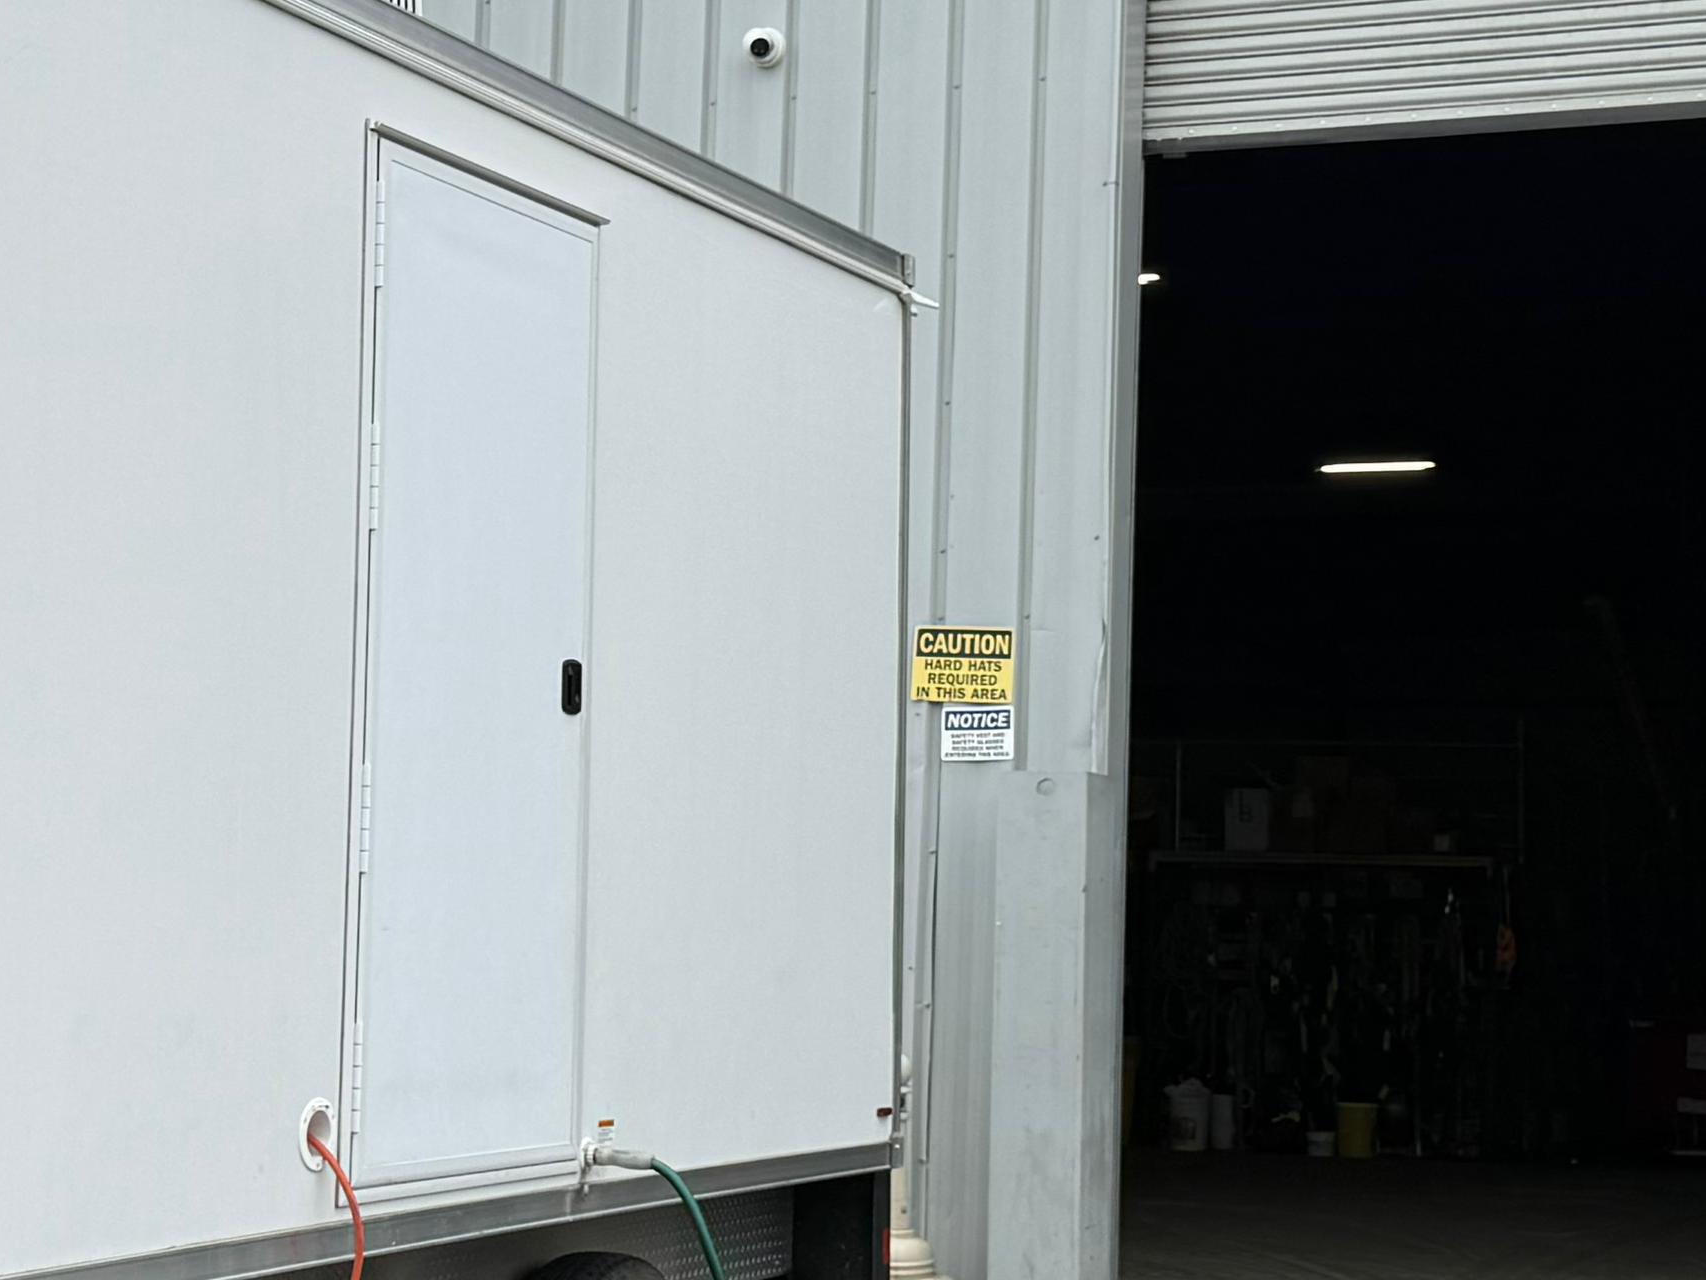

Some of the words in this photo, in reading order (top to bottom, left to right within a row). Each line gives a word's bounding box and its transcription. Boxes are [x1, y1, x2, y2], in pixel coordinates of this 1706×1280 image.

[919, 632, 1010, 655] CAUTION
[925, 659, 963, 671] HARD
[969, 660, 1002, 672] HATS
[927, 673, 997, 686] REQUIRED
[916, 686, 930, 698] IN
[935, 687, 965, 699] THIS
[971, 688, 1007, 700] AREA
[947, 712, 1009, 728] NOTICE
